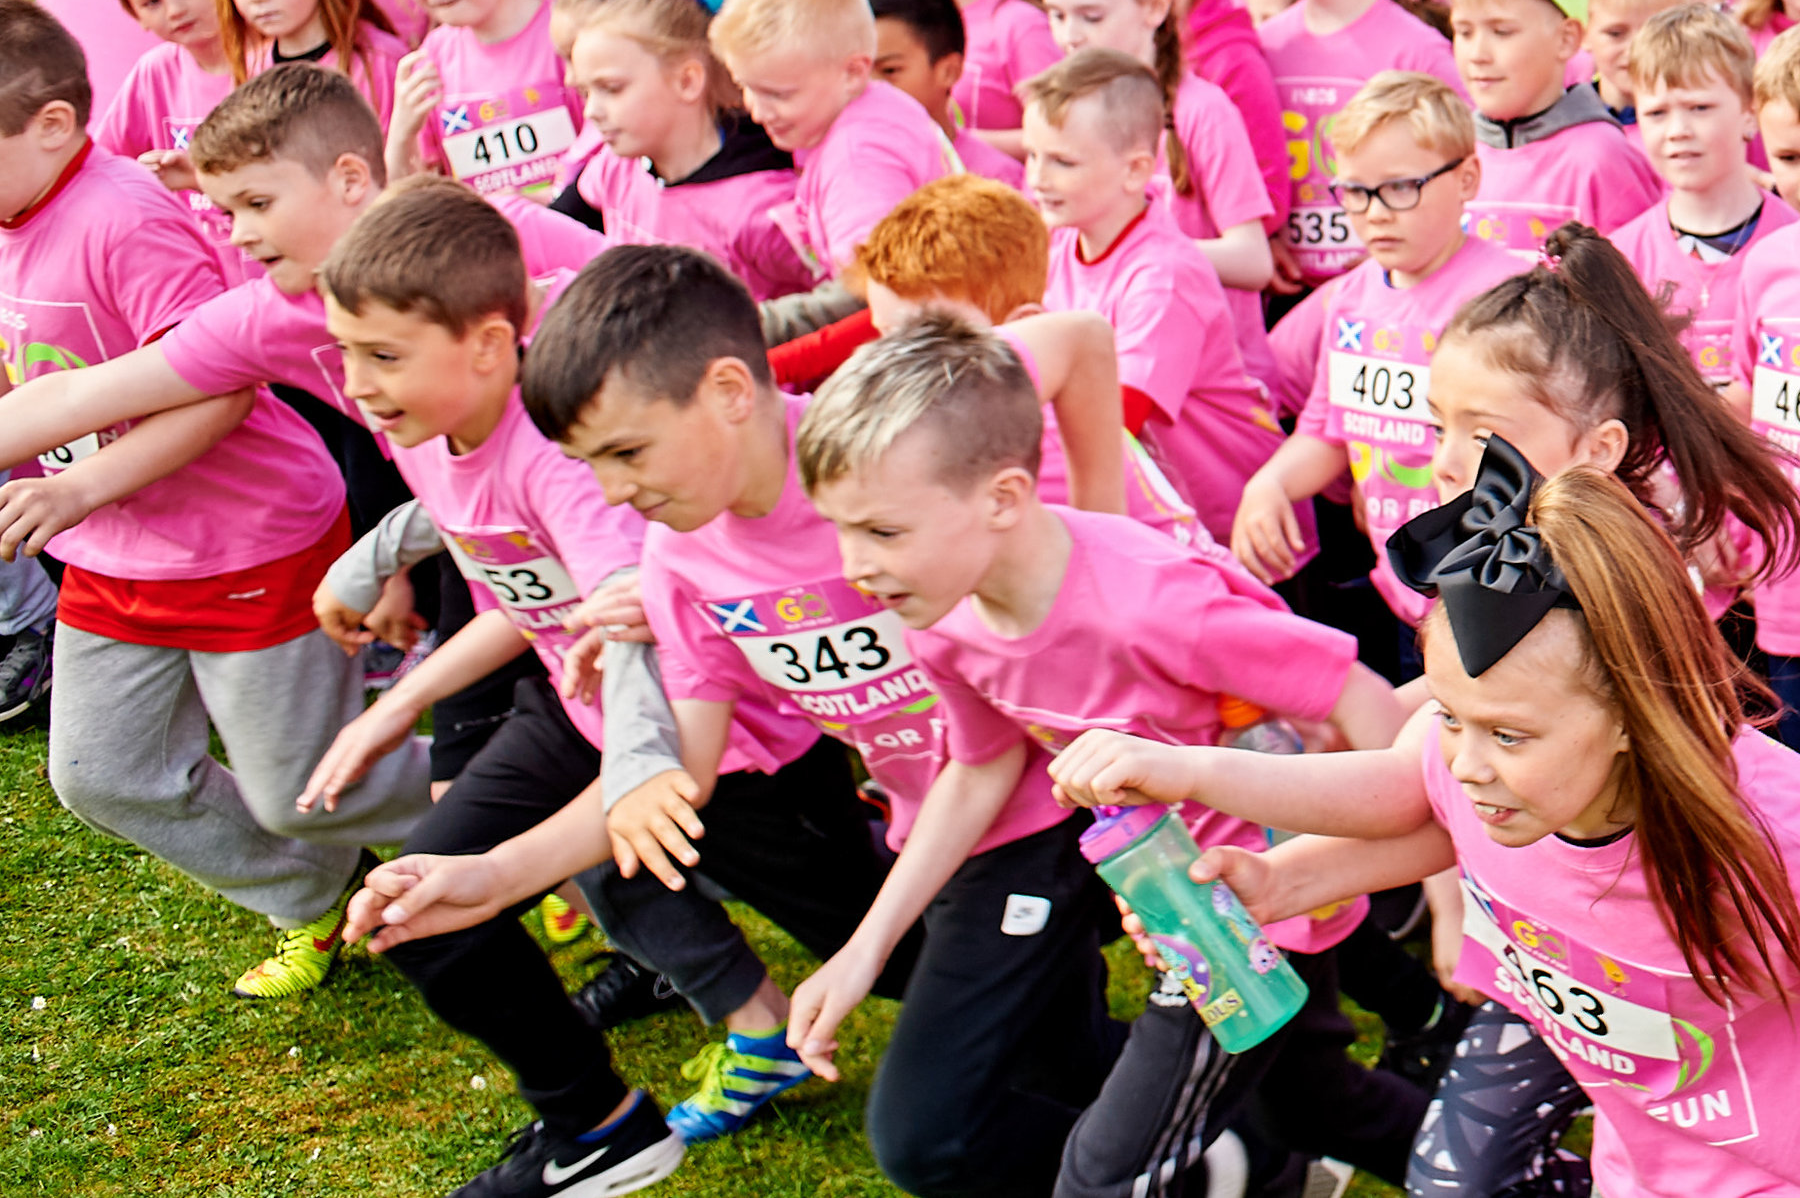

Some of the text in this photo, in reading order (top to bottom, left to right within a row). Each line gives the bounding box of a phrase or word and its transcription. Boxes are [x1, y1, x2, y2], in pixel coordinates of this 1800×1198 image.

[474, 123, 538, 164] 410
[1288, 212, 1349, 244] 535
[1353, 362, 1414, 410] 403
[1342, 410, 1426, 446] SCOTLAND
[770, 626, 891, 684] 343
[789, 668, 931, 717] SCOTLAND
[1646, 1089, 1732, 1128] FUN
